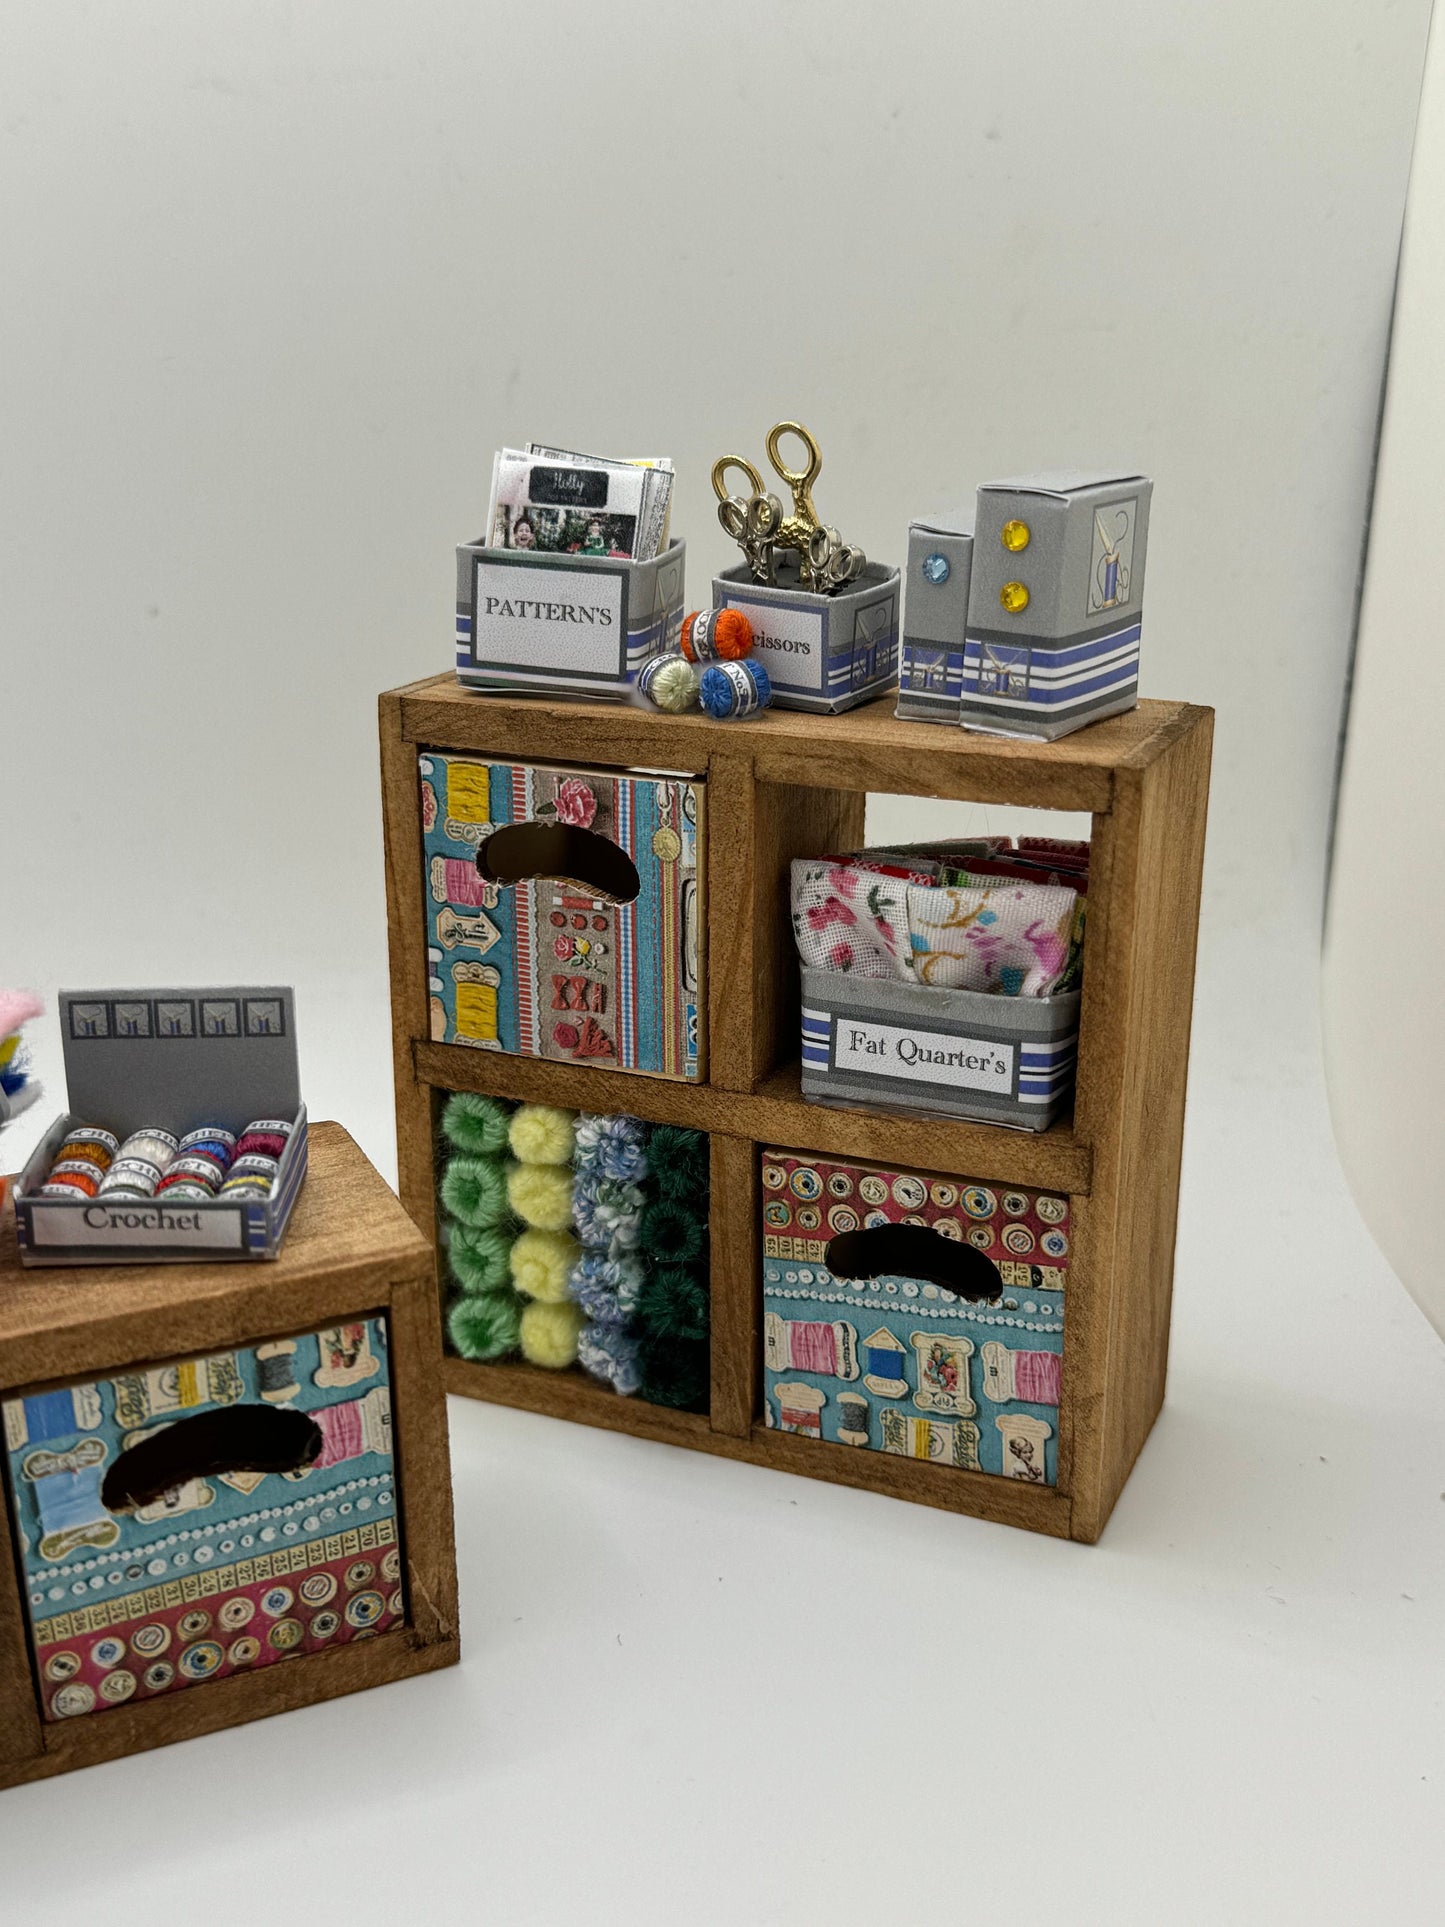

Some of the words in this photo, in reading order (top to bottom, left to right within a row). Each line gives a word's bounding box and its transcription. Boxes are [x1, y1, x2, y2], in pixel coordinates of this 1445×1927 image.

[552, 472, 585, 496] Holly
[485, 596, 612, 626] PATTERN'S
[751, 630, 811, 655] cissors
[849, 1029, 887, 1056] Fat
[895, 1037, 1007, 1075] Quarter's
[82, 1205, 203, 1231] Crochet
